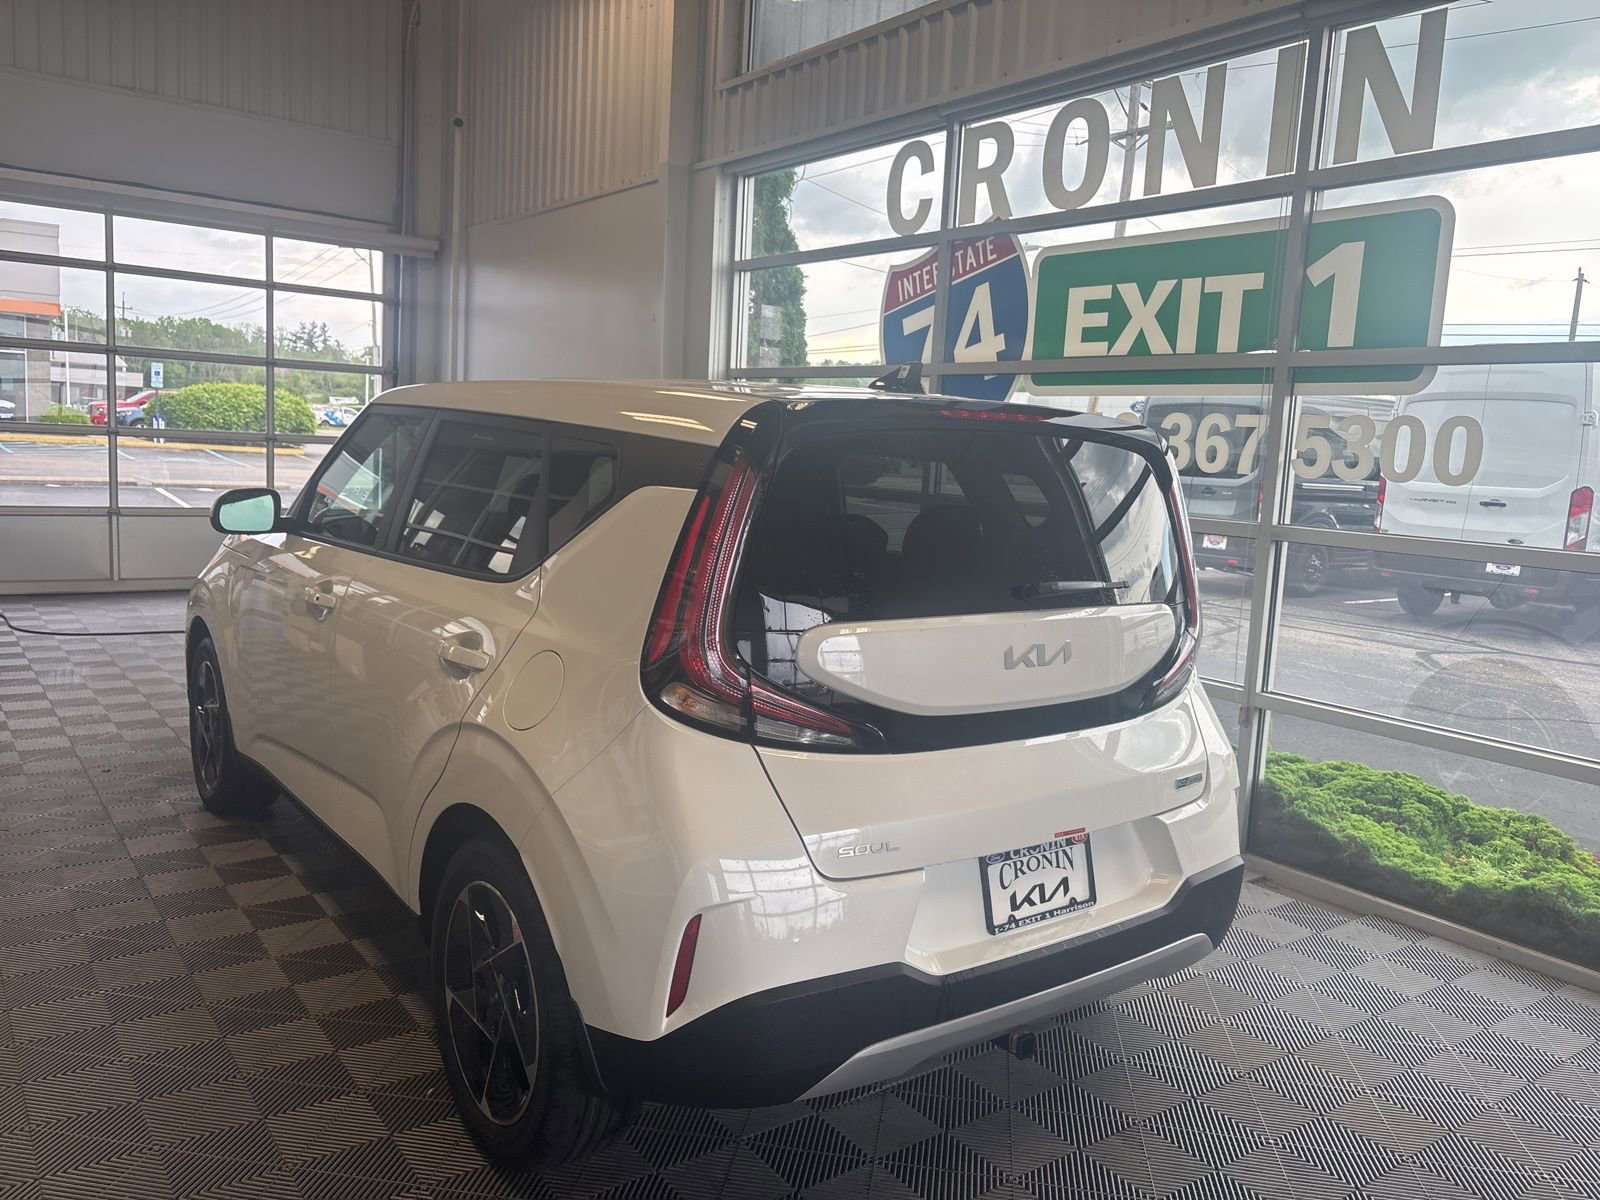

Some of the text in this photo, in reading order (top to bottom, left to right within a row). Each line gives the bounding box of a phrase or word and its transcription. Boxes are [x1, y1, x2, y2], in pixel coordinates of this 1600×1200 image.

[887, 8, 1449, 236] CRONIN
[897, 236, 998, 302] INTETATE
[1063, 241, 1366, 357] EXIT 1
[902, 281, 1006, 394] 74
[1003, 640, 1073, 671] KIA
[837, 842, 900, 858] SOUL
[999, 847, 1074, 890] CRONIN
[1009, 876, 1070, 913] KIA
[994, 923, 1017, 935] I-74
[1018, 915, 1042, 927] EXIT
[1054, 901, 1095, 917] Harrison
